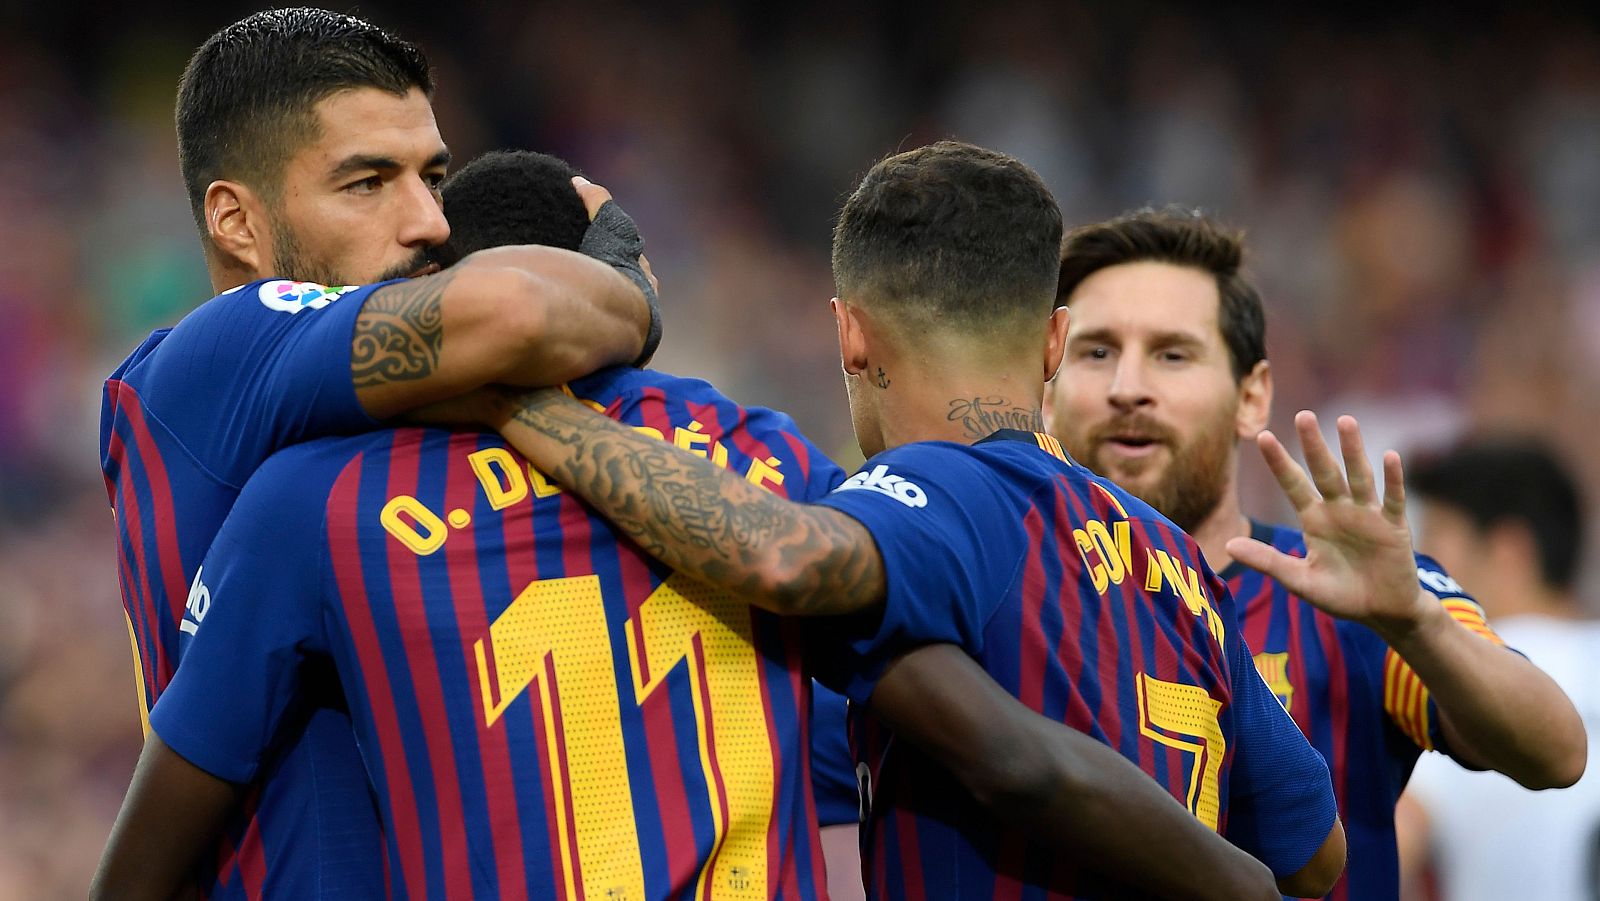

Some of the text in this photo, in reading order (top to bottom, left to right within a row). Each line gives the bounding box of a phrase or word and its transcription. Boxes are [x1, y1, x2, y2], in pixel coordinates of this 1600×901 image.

[380, 494, 472, 557] O.
[473, 572, 775, 901] 11
[1135, 671, 1227, 833] 7
